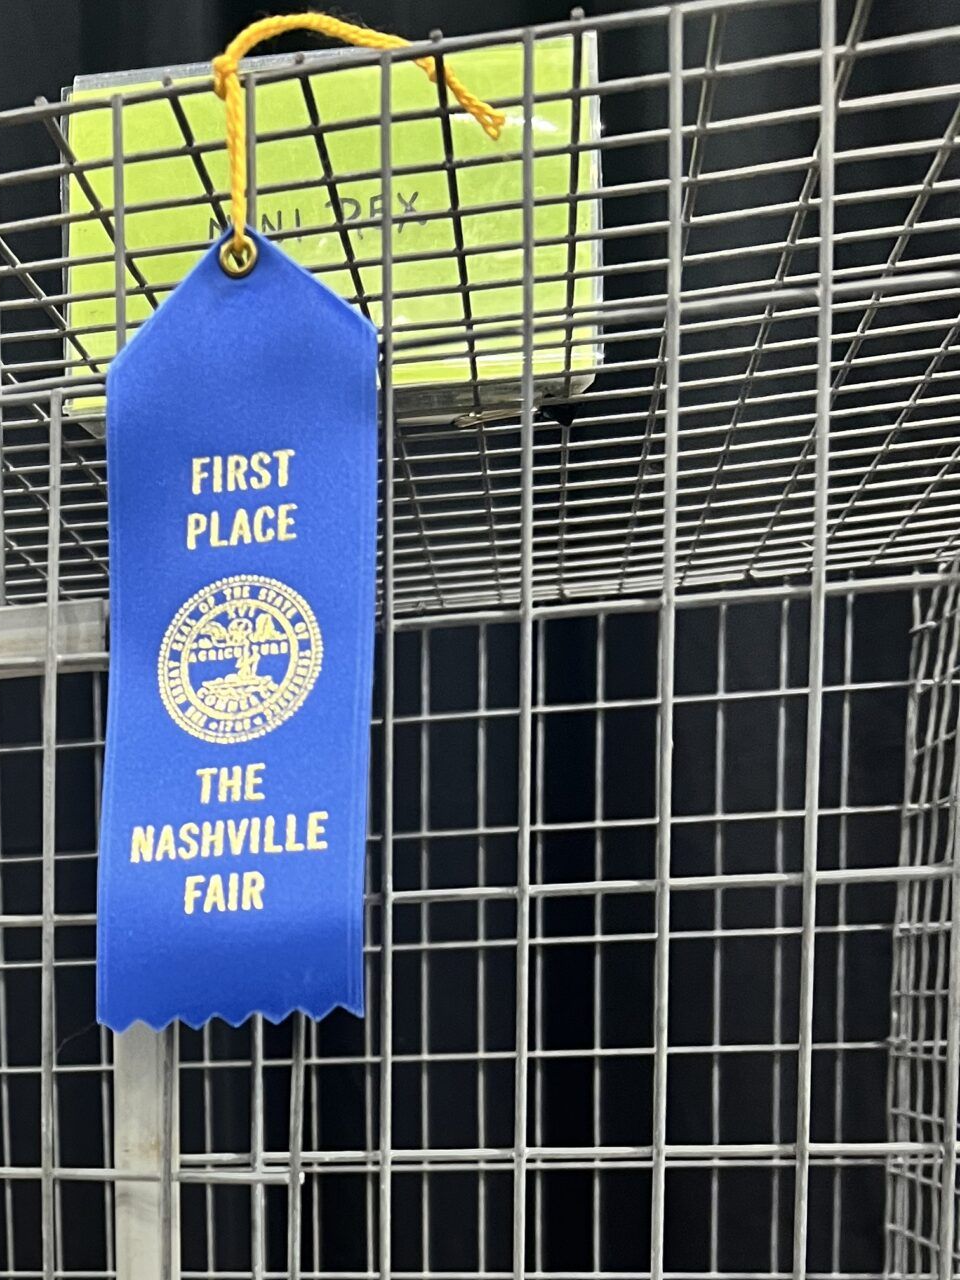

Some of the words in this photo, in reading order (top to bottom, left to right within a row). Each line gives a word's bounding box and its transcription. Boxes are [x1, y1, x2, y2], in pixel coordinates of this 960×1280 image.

[209, 208, 302, 243] MNI
[191, 449, 295, 495] FIRST
[186, 503, 298, 550] PLACE
[196, 763, 266, 804] THE
[130, 811, 329, 863] NASHVILLE
[184, 871, 266, 915] FAIR
